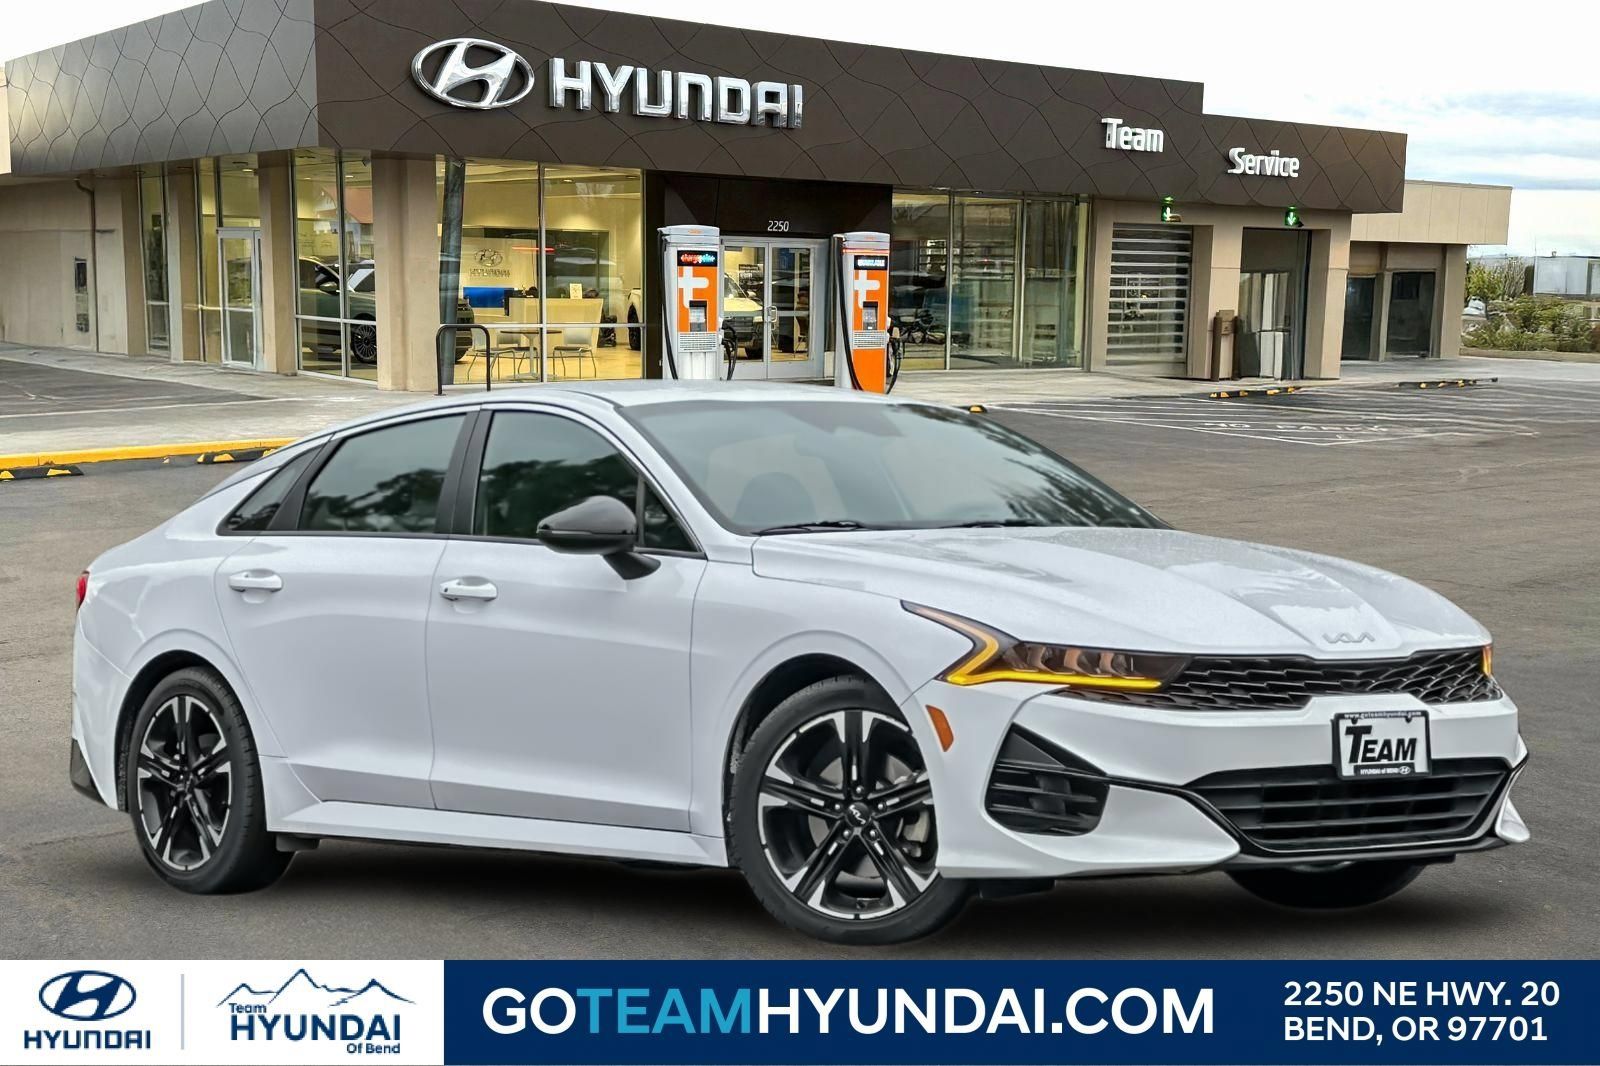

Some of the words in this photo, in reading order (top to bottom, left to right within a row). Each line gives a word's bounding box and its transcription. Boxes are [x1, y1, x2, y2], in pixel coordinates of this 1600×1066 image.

[549, 57, 804, 129] HYUNDAI
[1101, 117, 1164, 153] Team
[1228, 147, 1300, 178] Service
[767, 219, 790, 232] 2250
